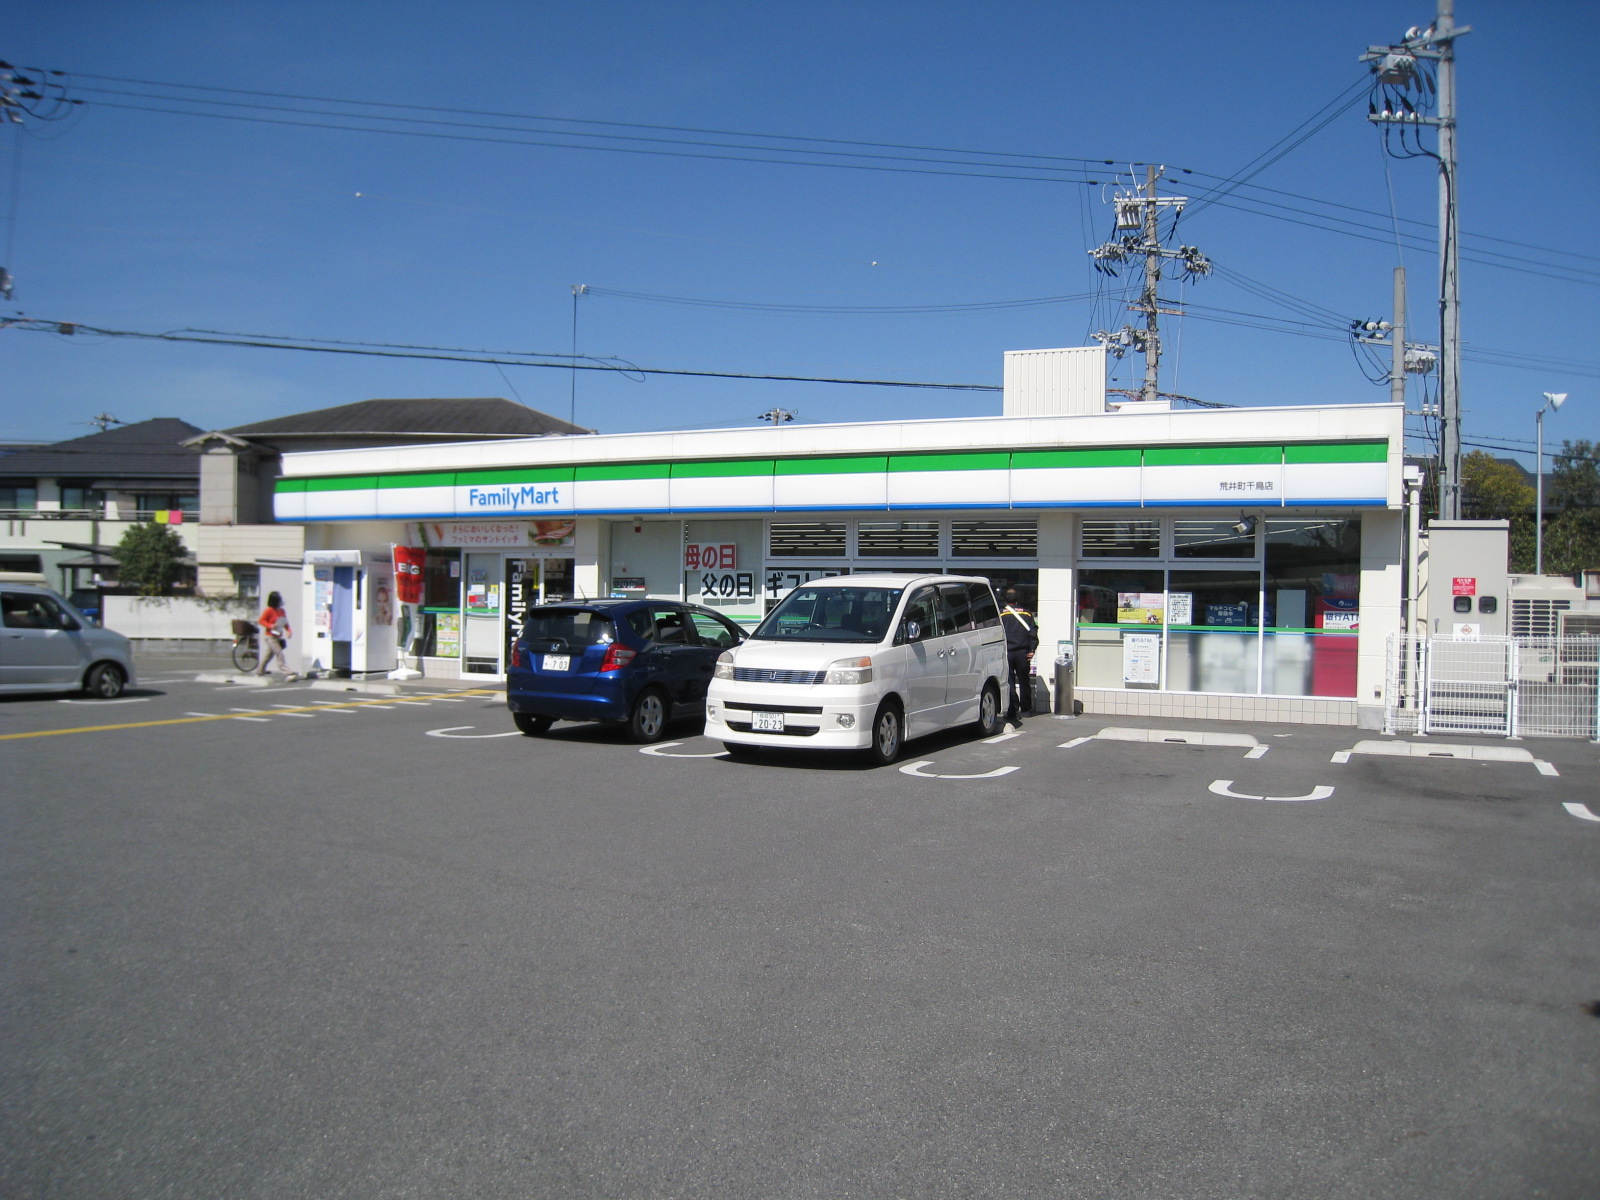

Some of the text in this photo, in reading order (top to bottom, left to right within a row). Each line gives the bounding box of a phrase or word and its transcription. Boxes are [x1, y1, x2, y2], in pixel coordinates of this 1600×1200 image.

[469, 486, 559, 510] FamilyMart
[1219, 481, 1274, 491] 荒井町千鳥店
[452, 535, 519, 544] ファミマのサンドイッチ
[685, 544, 736, 569] 母の日
[701, 572, 753, 597] 父の日
[507, 561, 527, 647] FamilyM
[759, 719, 782, 730] 20-23
